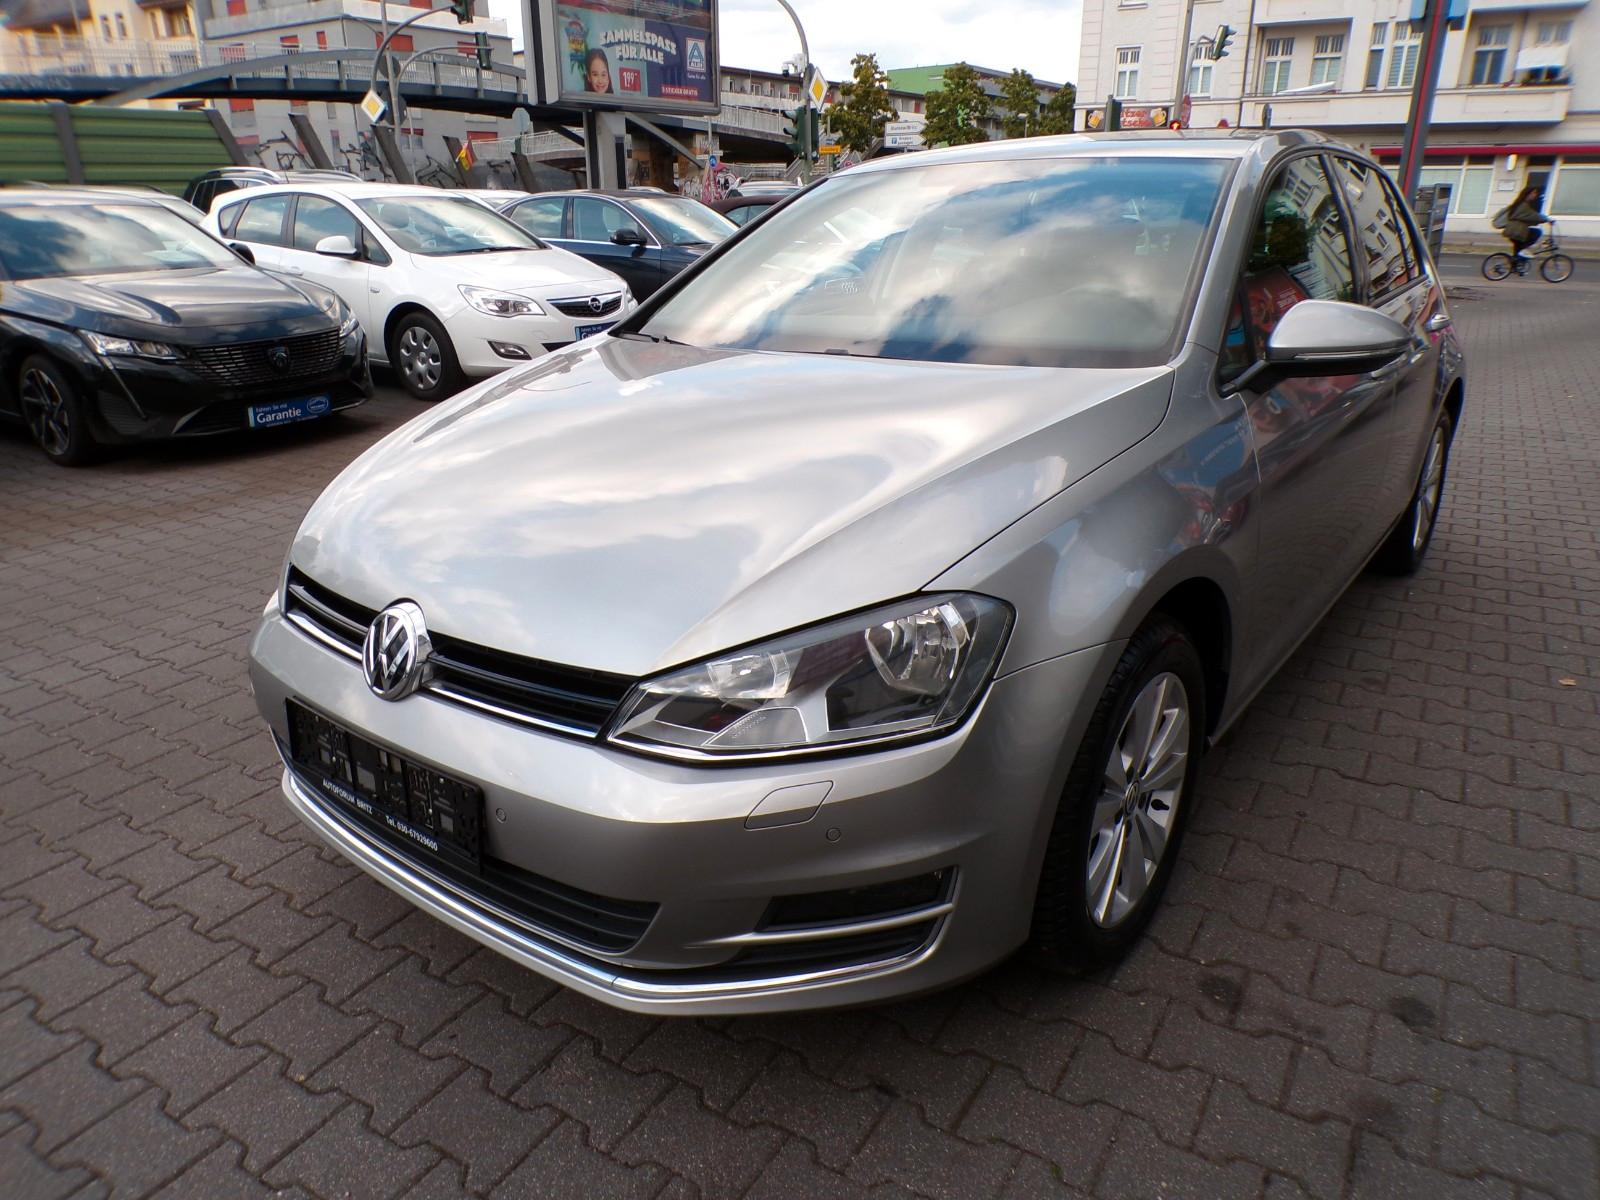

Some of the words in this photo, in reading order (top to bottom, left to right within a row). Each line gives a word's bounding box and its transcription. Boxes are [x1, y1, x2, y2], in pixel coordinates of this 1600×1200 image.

[600, 28, 677, 55] SAMMELSPASS
[639, 47, 664, 64] ALLE
[256, 407, 302, 423] Garantie
[322, 778, 355, 804] AUTOFORUM
[356, 799, 373, 815] BRITZ
[385, 815, 397, 828] Tel.
